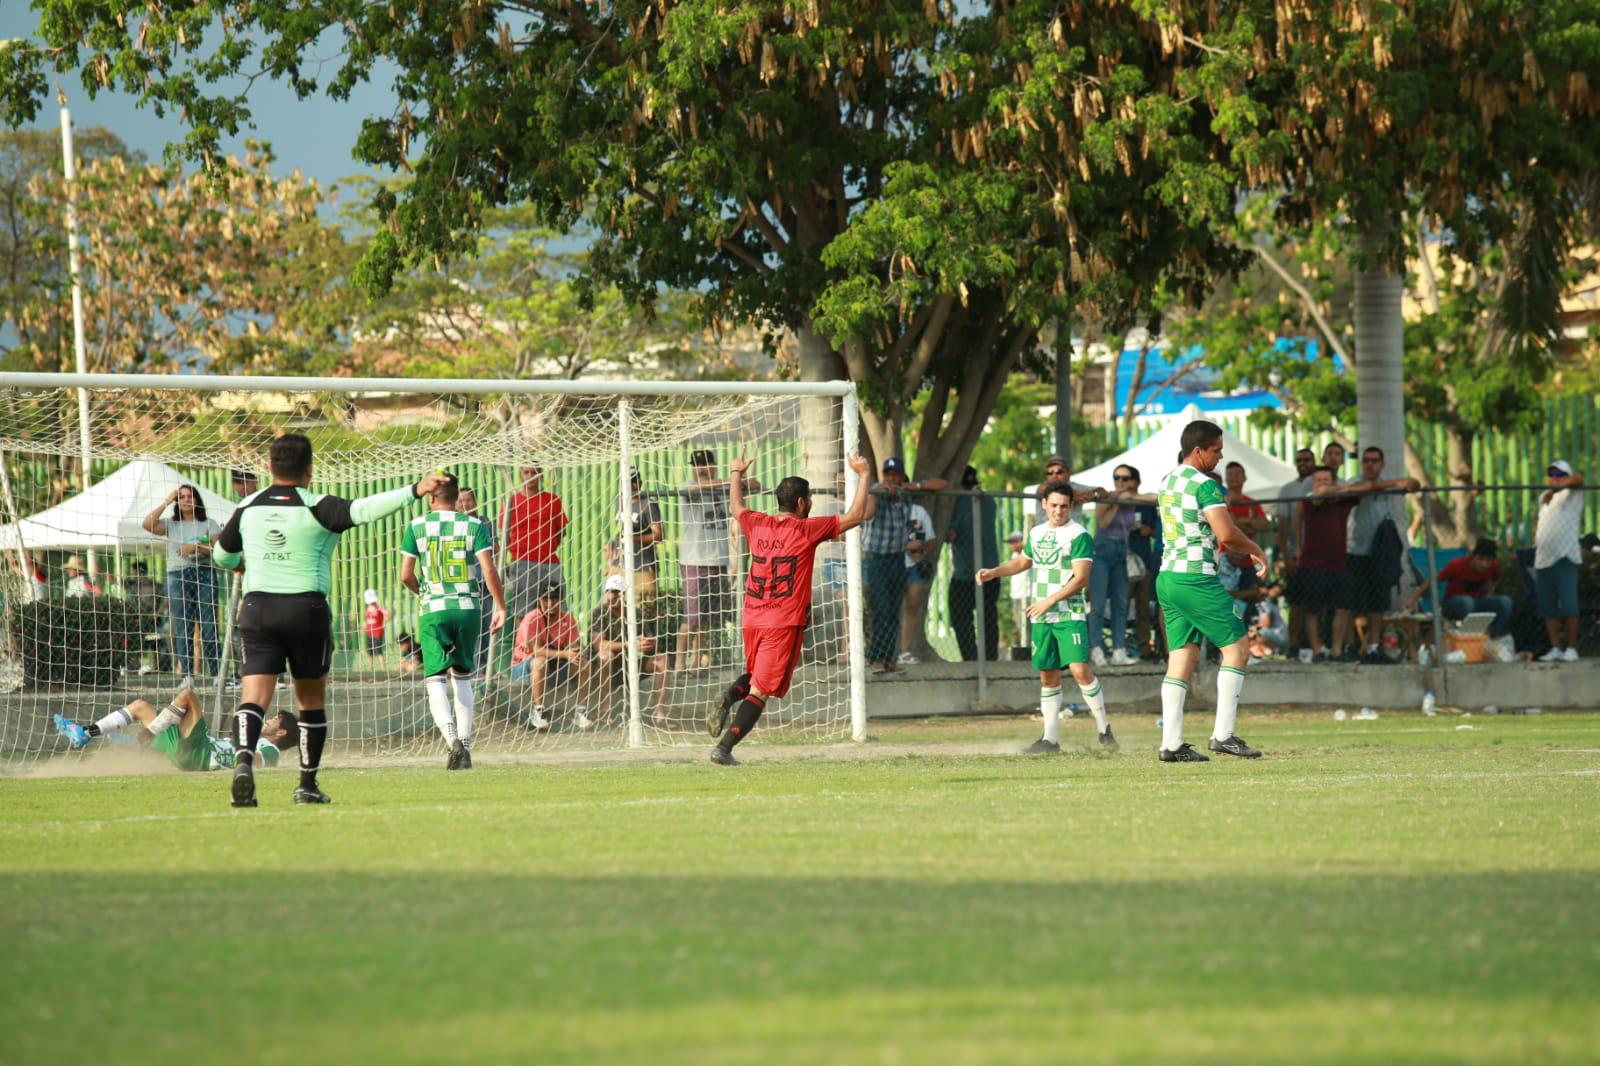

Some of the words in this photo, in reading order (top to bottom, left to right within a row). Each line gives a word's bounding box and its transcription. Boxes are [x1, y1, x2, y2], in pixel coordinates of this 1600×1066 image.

[263, 552, 291, 561] AT&T
[426, 540, 468, 583] 16
[746, 555, 798, 600] 58
[1072, 633, 1081, 645] 11
